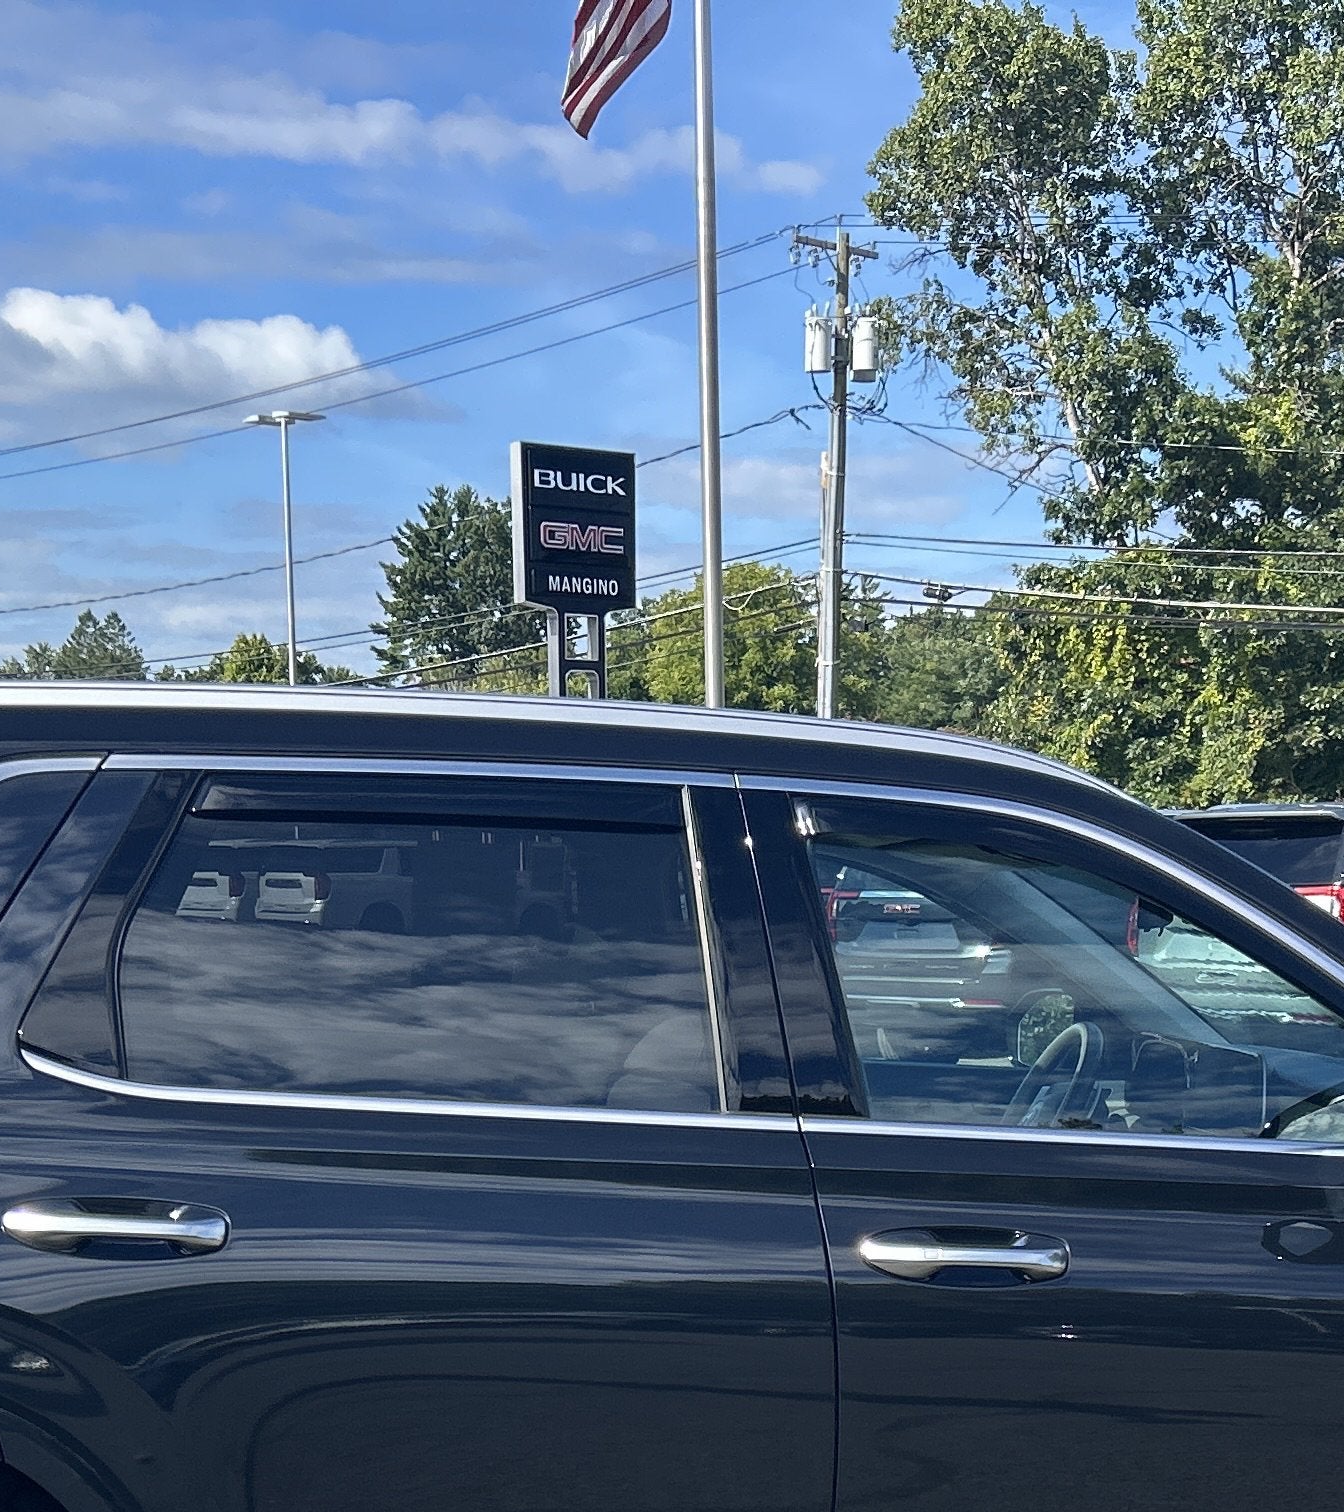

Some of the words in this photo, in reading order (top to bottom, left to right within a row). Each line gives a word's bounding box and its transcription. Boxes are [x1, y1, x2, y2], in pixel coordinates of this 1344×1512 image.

[533, 468, 627, 496] BUICK
[540, 521, 624, 554] GMC
[548, 575, 619, 596] MANGINO
